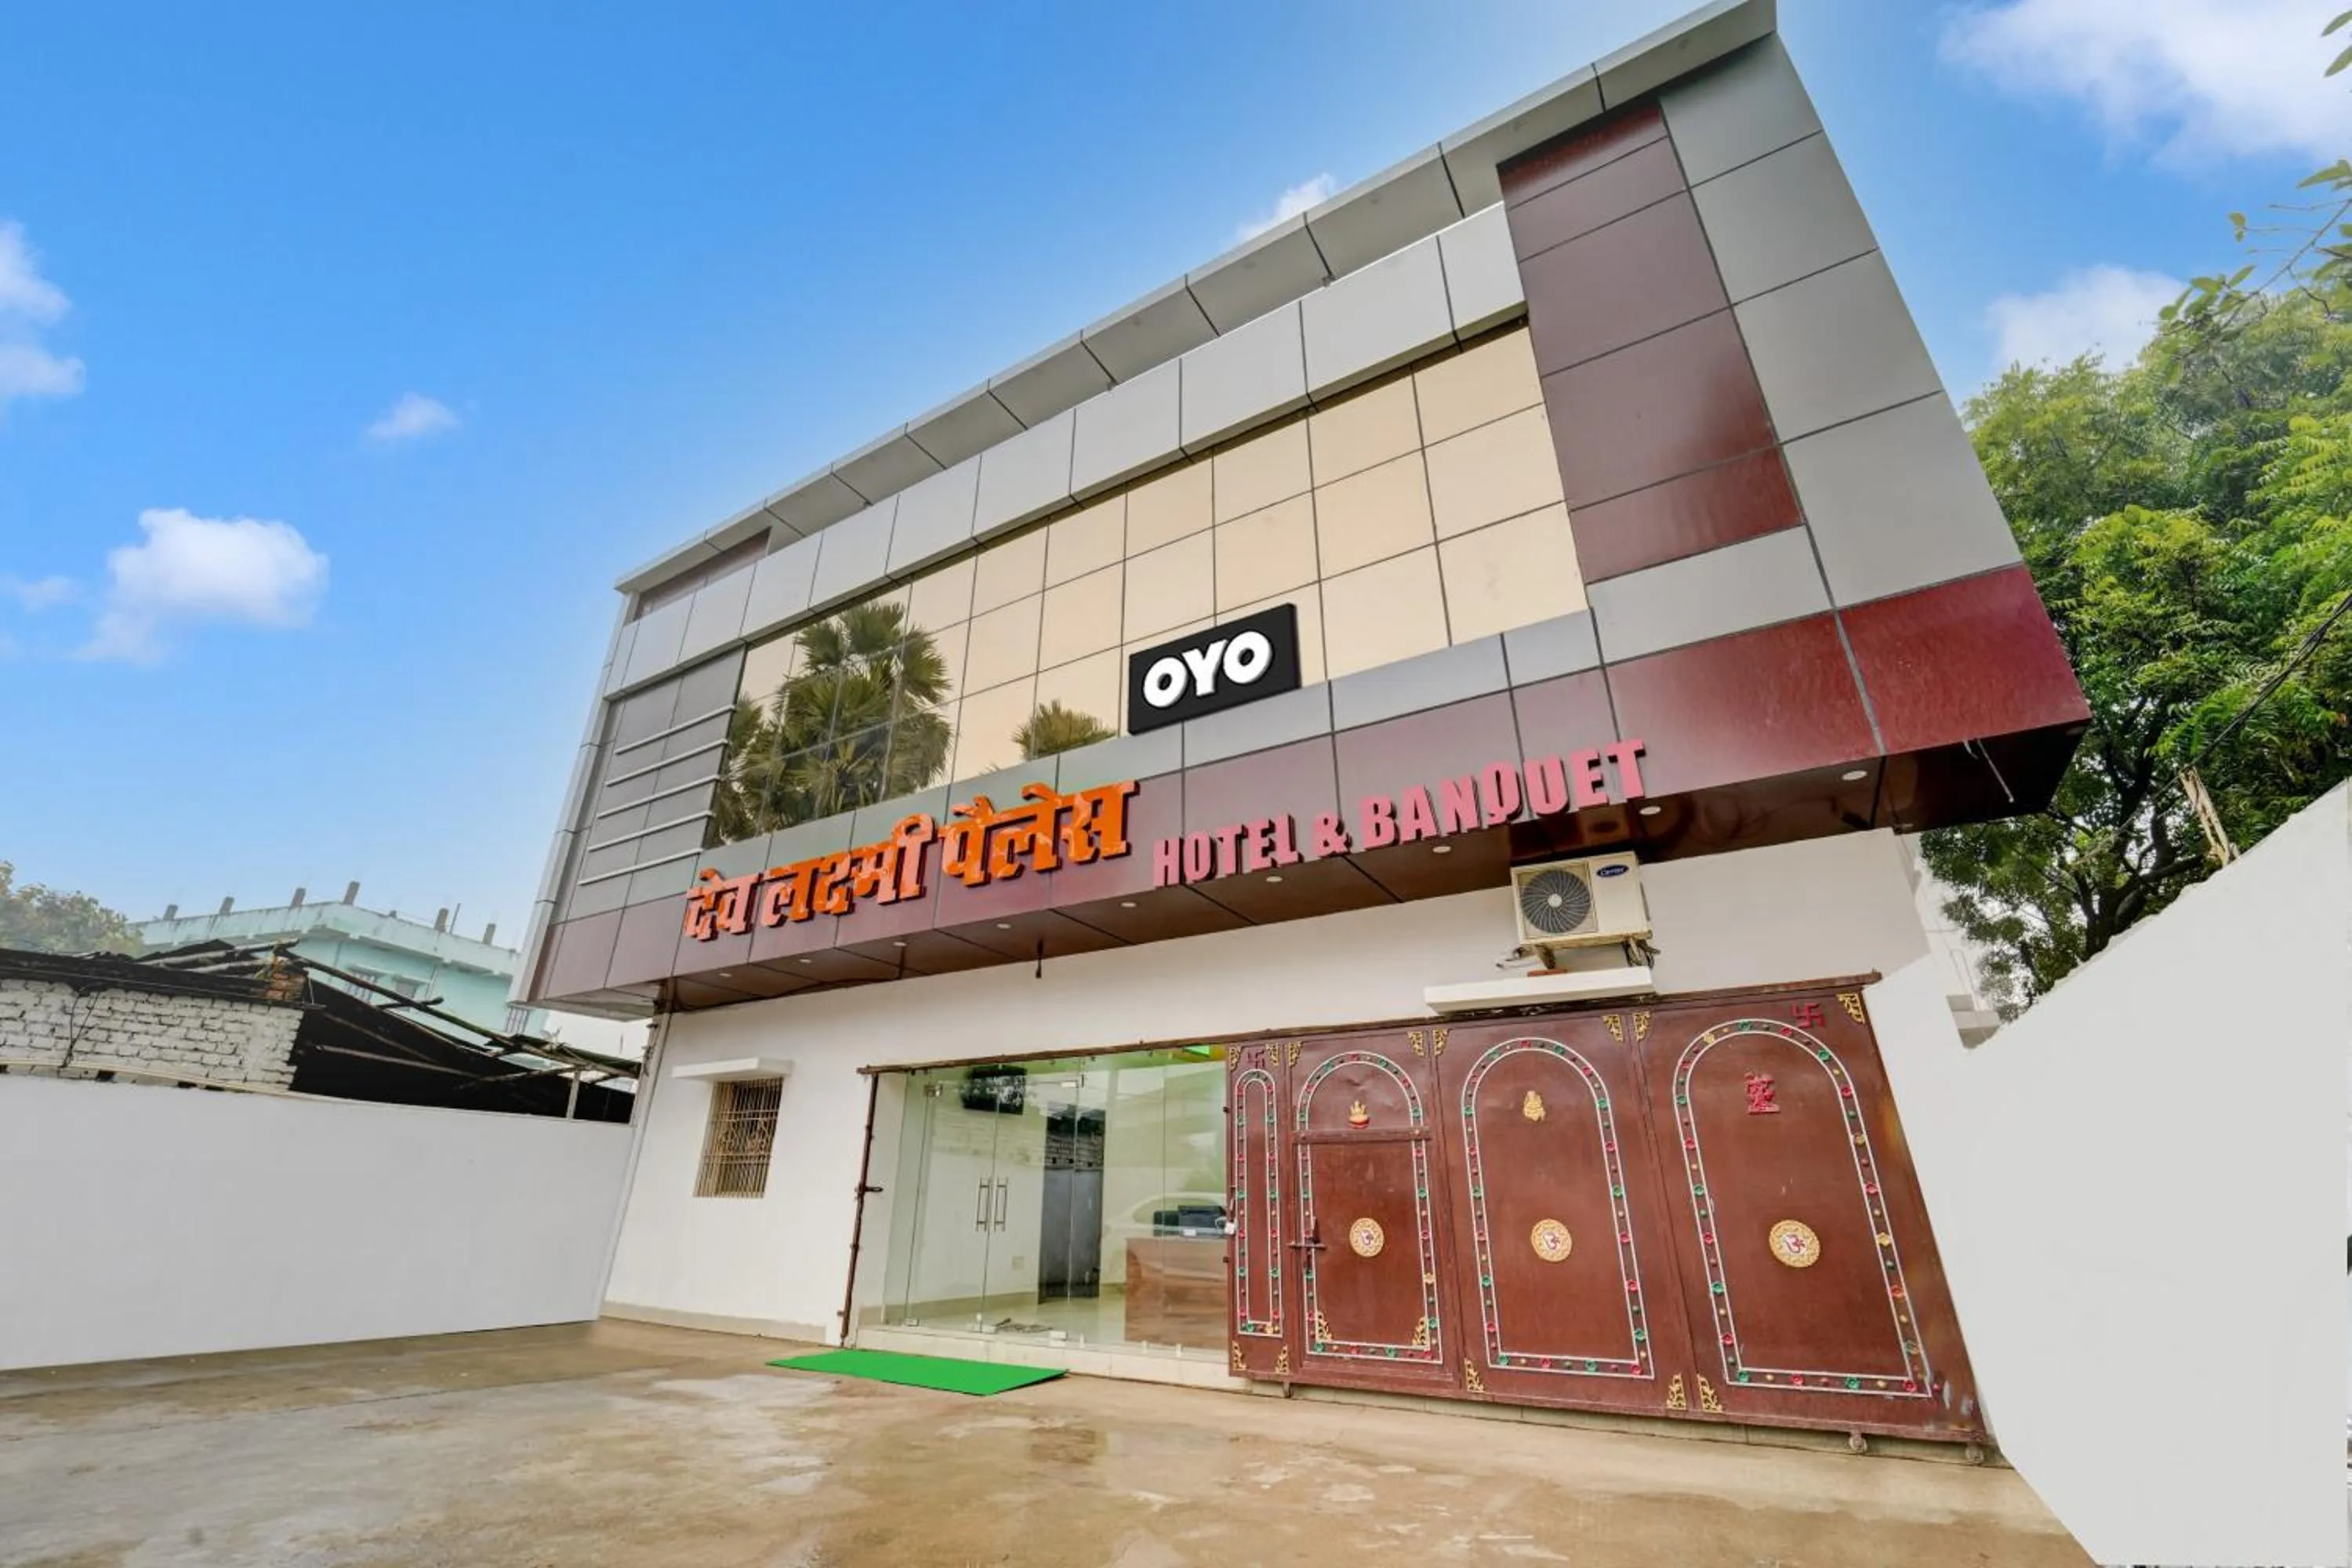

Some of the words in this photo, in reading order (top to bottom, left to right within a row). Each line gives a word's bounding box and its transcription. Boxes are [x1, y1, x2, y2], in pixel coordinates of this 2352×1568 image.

[1142, 630, 1274, 708] OYO
[1153, 813, 1300, 887] HOTEL
[1313, 809, 1348, 857] &
[1359, 739, 1646, 850] BANQUET
[684, 867, 760, 941] देव
